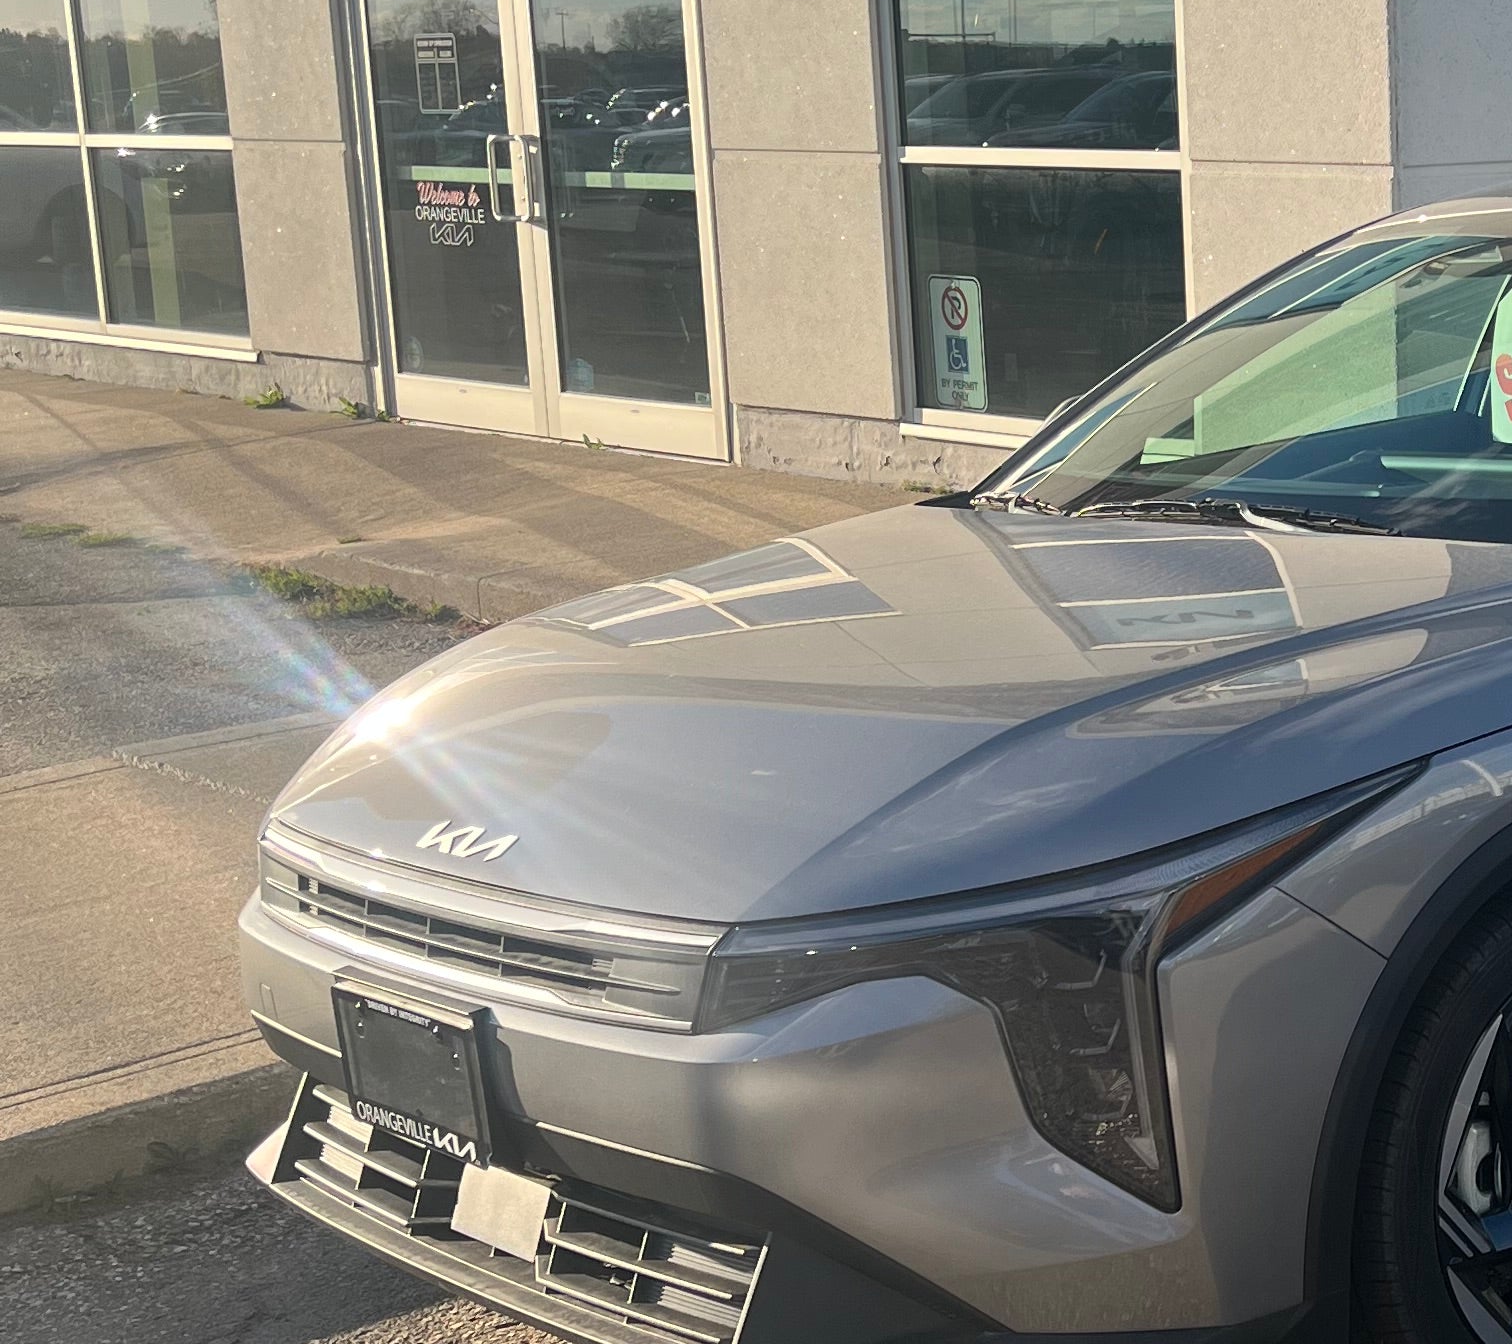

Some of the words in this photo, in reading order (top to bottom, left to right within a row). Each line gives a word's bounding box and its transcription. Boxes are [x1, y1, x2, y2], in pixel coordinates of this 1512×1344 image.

[416, 181, 465, 207] Welcome
[467, 184, 480, 207] to
[415, 205, 486, 224] ORANGEVILLE
[430, 222, 474, 246] KIA
[941, 378, 951, 388] BY
[416, 819, 520, 862] KIA
[356, 1100, 434, 1143] ORANGEVILLE
[433, 1127, 477, 1162] KIA
